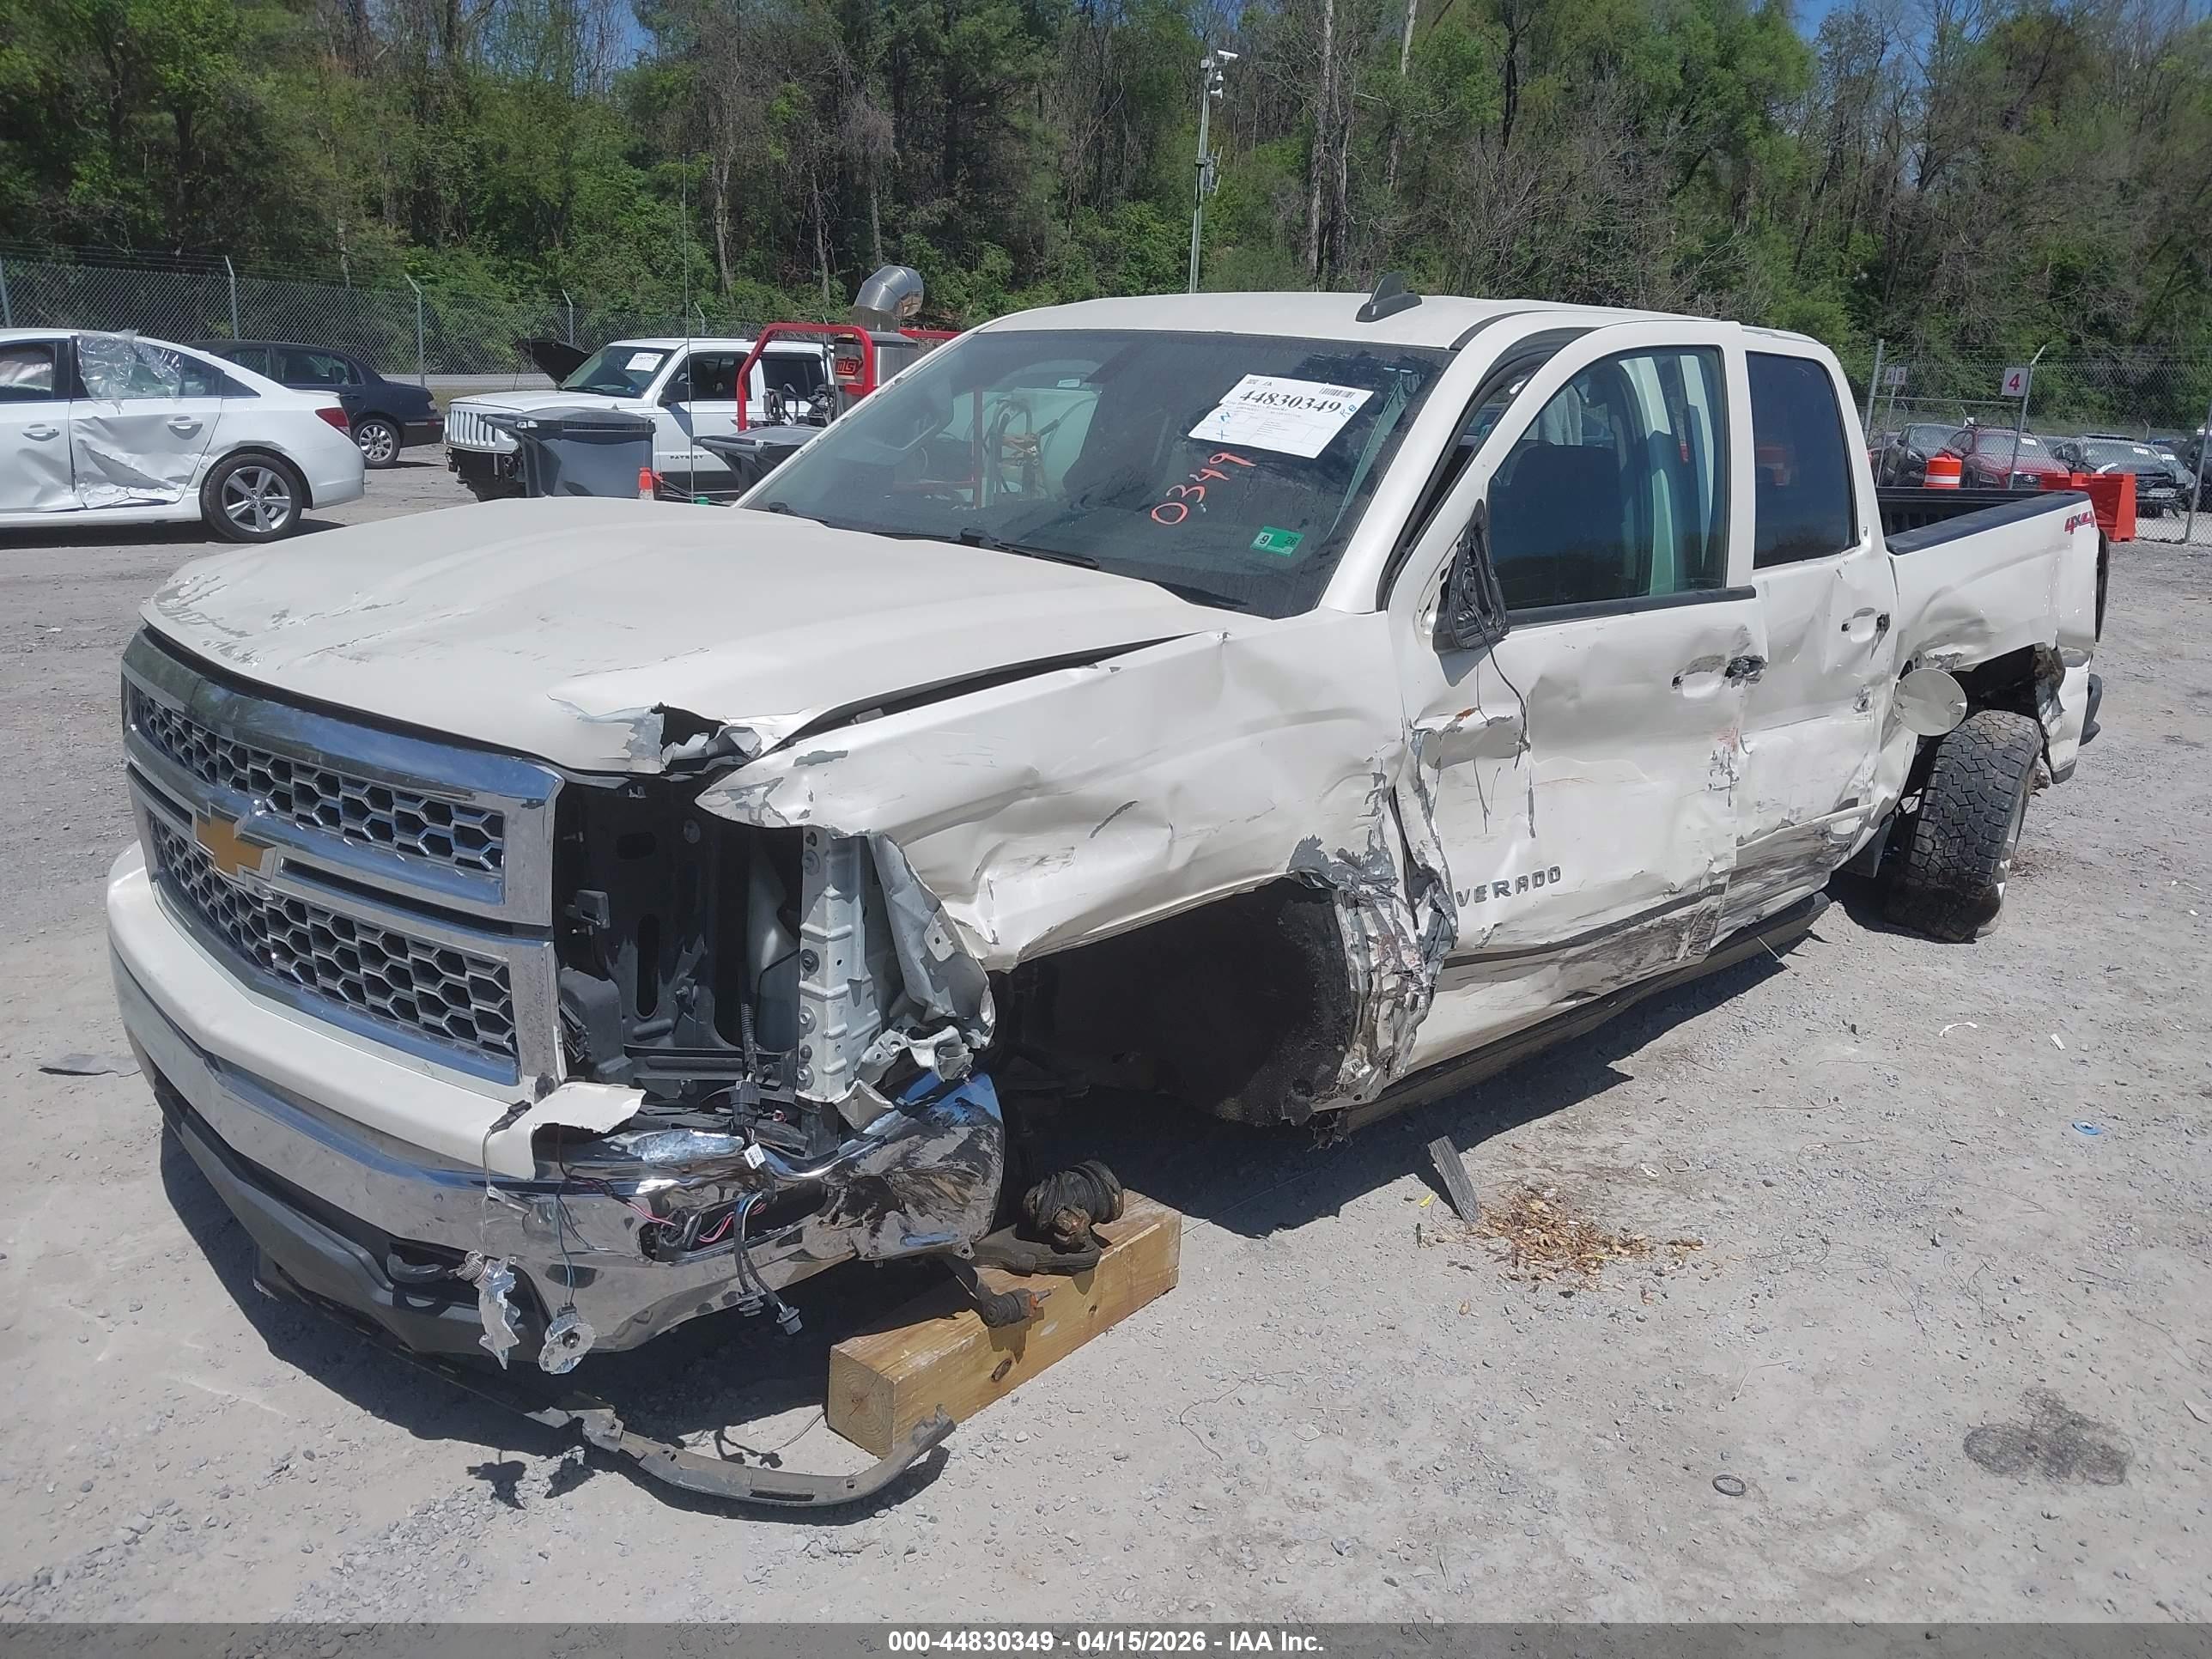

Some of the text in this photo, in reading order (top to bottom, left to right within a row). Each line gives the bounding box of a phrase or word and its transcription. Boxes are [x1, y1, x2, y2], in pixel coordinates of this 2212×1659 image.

[2007, 373, 2020, 391] 4
[1239, 390, 1342, 413] 44830349
[1151, 453, 1257, 526] 0349
[1260, 535, 1270, 544] 9
